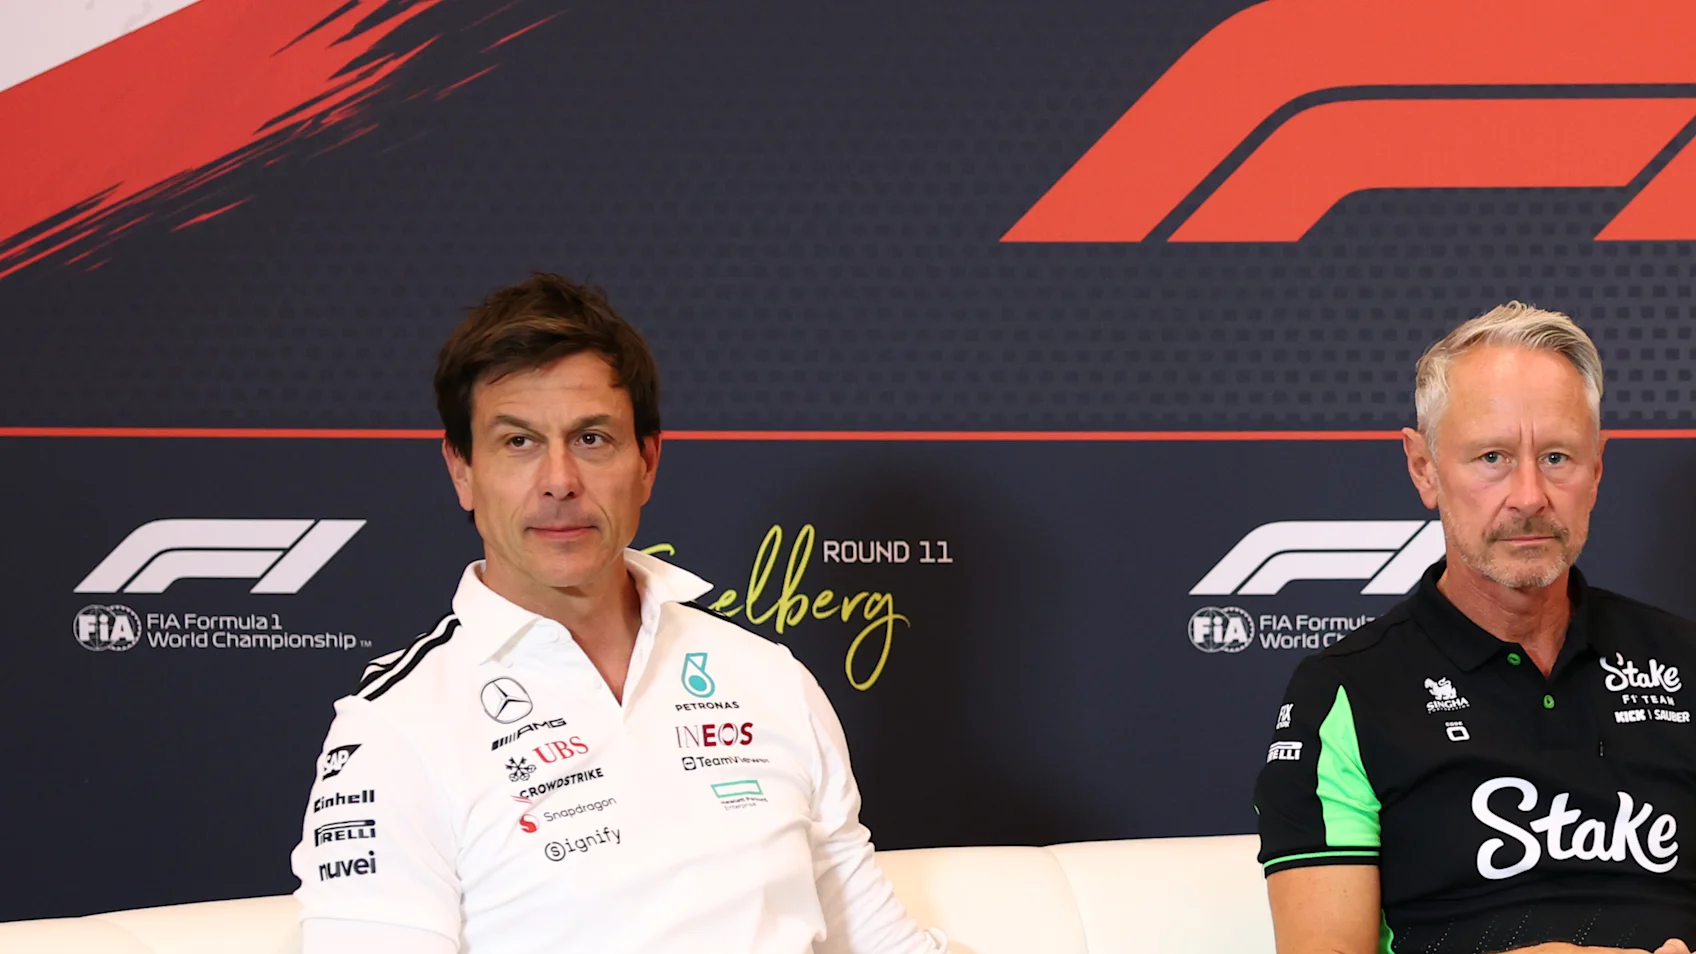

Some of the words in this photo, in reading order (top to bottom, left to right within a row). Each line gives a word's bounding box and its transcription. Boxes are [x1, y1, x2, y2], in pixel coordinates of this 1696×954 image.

[73, 518, 367, 594] F1
[823, 540, 910, 563] ROUND
[919, 541, 953, 563] 11
[1188, 520, 1448, 595] F1
[147, 614, 180, 629] FIA
[184, 613, 270, 630] Formula
[271, 613, 282, 629] 1
[1259, 615, 1293, 631] FIA
[147, 632, 208, 648] World
[211, 632, 356, 651] Championship
[1259, 632, 1319, 649] World
[1599, 652, 1682, 692] Stake
[675, 701, 740, 711] PETRONAS
[1426, 697, 1469, 710] SINGHA
[1641, 695, 1675, 706] TEAM
[1614, 709, 1646, 723] KICK
[1654, 709, 1690, 723] SAUBER
[516, 718, 567, 739] AMG
[675, 722, 753, 748] INEOS
[532, 736, 589, 763] UBS
[519, 768, 604, 799] CROWDSTRIKE
[544, 797, 617, 822] Snapdragon
[1471, 776, 1679, 880] Stake
[319, 850, 376, 881] nuvei
